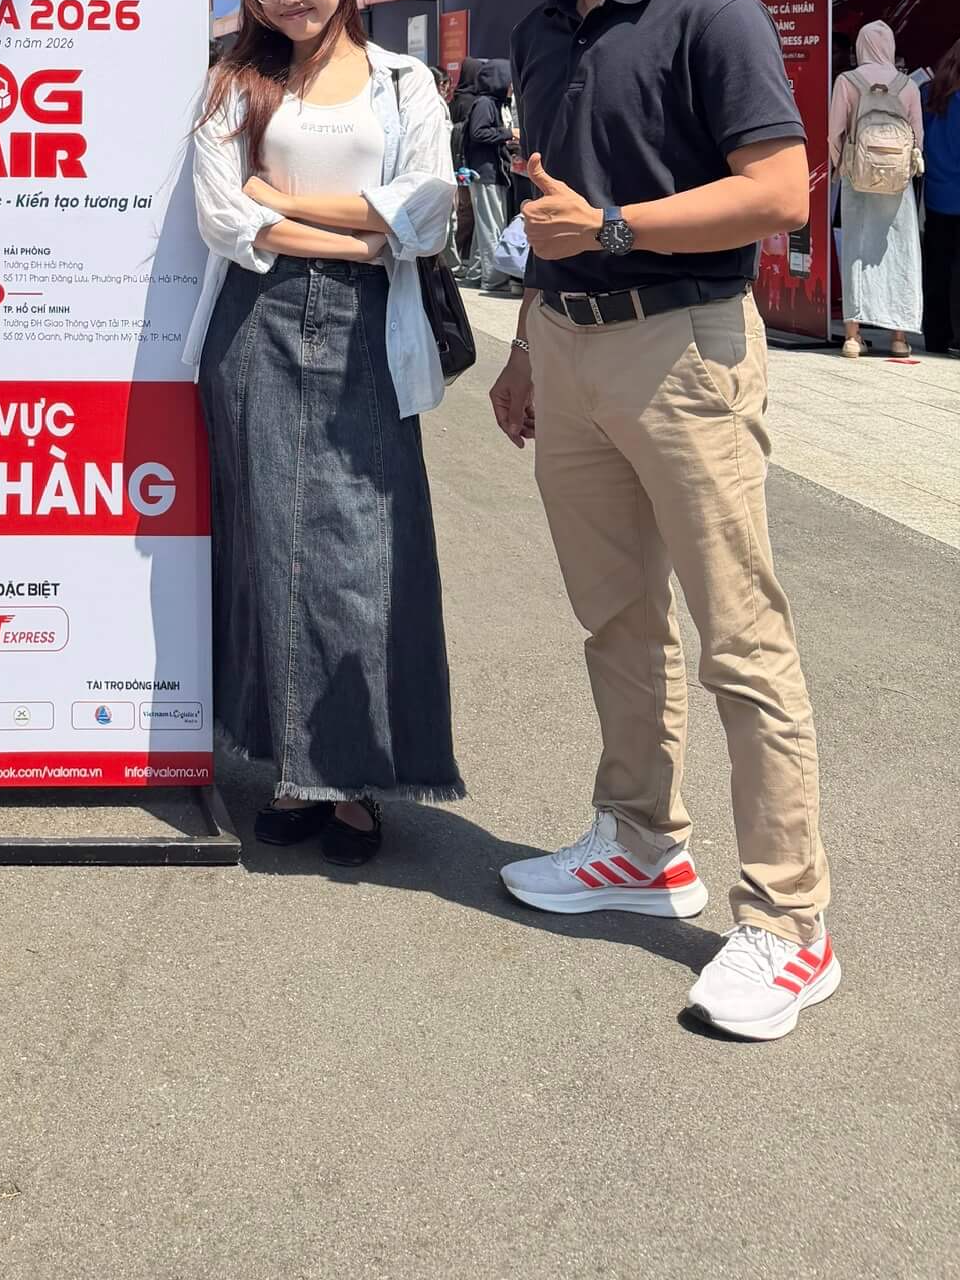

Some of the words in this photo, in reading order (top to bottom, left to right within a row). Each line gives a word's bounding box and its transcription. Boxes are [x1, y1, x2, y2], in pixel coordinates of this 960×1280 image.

[779, 2, 790, 14] CÁ
[30, 0, 140, 31] 2026
[4, 37, 11, 48] 3
[15, 37, 41, 49] năm
[46, 37, 74, 49] 2026
[803, 35, 820, 45] APP
[15, 191, 49, 208] Kiến
[54, 195, 79, 211] tạo
[84, 195, 128, 212] tương
[132, 195, 152, 209] lai
[20, 246, 51, 256] PHÒNG
[30, 261, 42, 269] ĐH
[59, 261, 84, 271] Phòng
[15, 274, 28, 282] 171
[29, 274, 50, 283] Phan
[173, 274, 198, 285] Phòng
[4, 306, 14, 314] TP.
[30, 303, 47, 314] CHÍ
[48, 306, 70, 314] MINH
[30, 319, 42, 328] ĐH
[44, 319, 64, 328] Giao
[65, 319, 89, 329] Thông
[132, 319, 151, 328] HCM
[14, 333, 24, 341] 02
[162, 333, 181, 341] HCM
[28, 580, 60, 599] BIỆT
[3, 631, 56, 644] EXPRESS
[86, 679, 103, 690] TÀI
[105, 680, 125, 692] TRỢ
[125, 678, 152, 690] ĐỒNG
[153, 679, 180, 691] HÀNH
